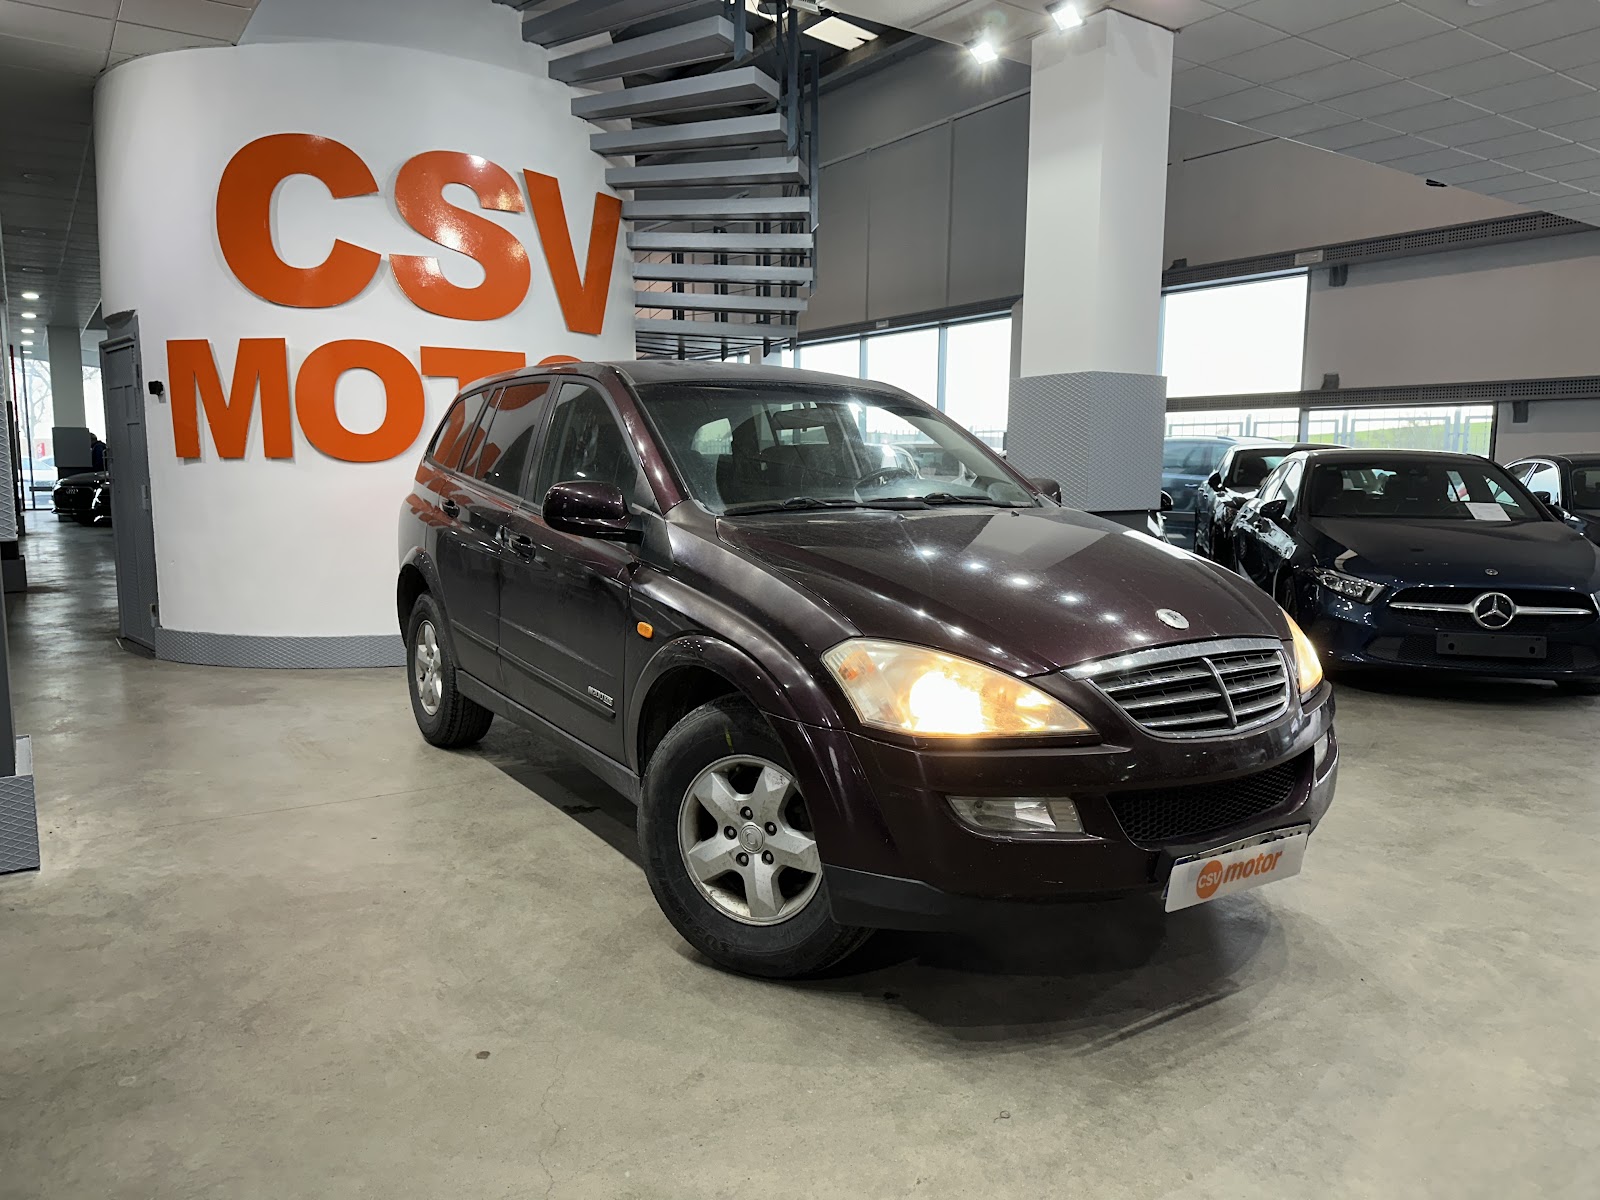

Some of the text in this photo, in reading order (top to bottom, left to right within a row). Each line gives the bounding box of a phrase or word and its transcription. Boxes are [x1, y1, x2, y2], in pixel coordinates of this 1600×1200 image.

[216, 133, 622, 335] CSV
[166, 337, 583, 462] MOT
[1223, 851, 1283, 884] motor
